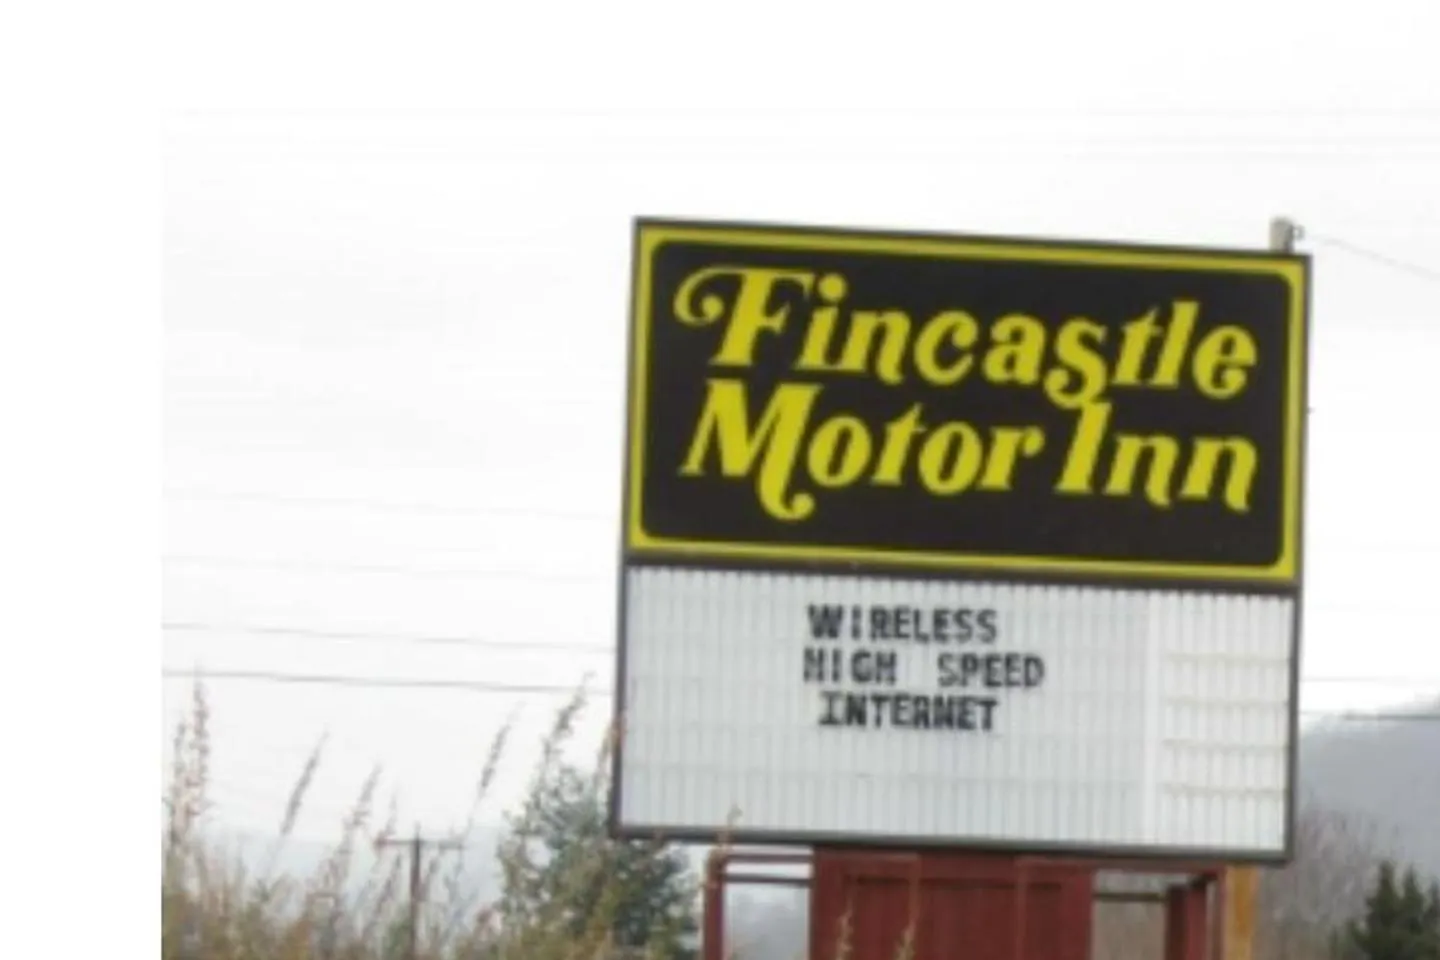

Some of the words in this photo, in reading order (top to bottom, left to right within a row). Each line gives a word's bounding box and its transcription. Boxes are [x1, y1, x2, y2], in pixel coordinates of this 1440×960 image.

[673, 266, 1257, 409] Fincastle
[679, 377, 1045, 520] Motor
[1055, 401, 1257, 511] Inn
[807, 604, 998, 643] WIRELESS
[803, 647, 897, 685] HIGH
[937, 651, 1045, 688] SPEED
[818, 690, 999, 731] INTERNET
